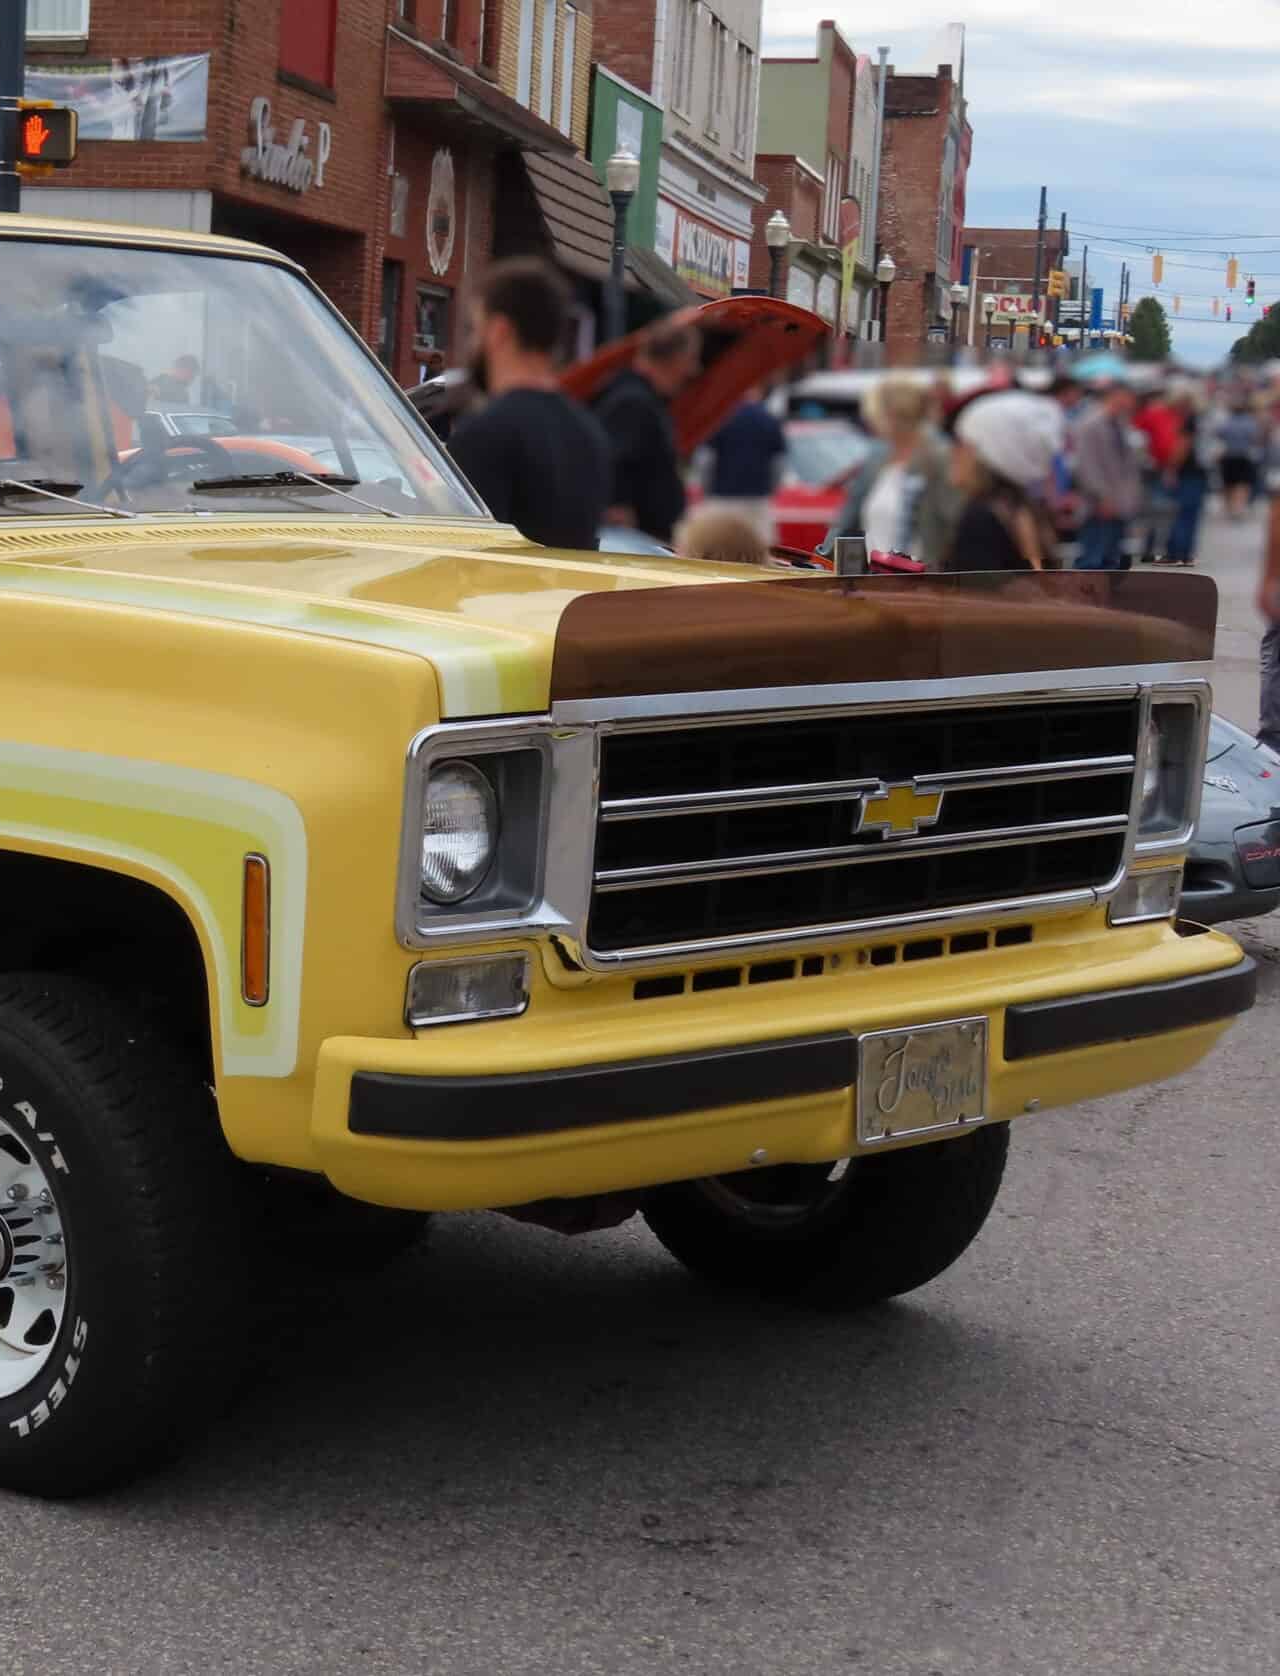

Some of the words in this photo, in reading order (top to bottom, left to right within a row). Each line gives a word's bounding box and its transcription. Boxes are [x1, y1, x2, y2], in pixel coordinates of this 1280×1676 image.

[315, 121, 331, 187] P
[14, 1100, 70, 1175] A/T
[9, 1315, 88, 1438] STEEL
